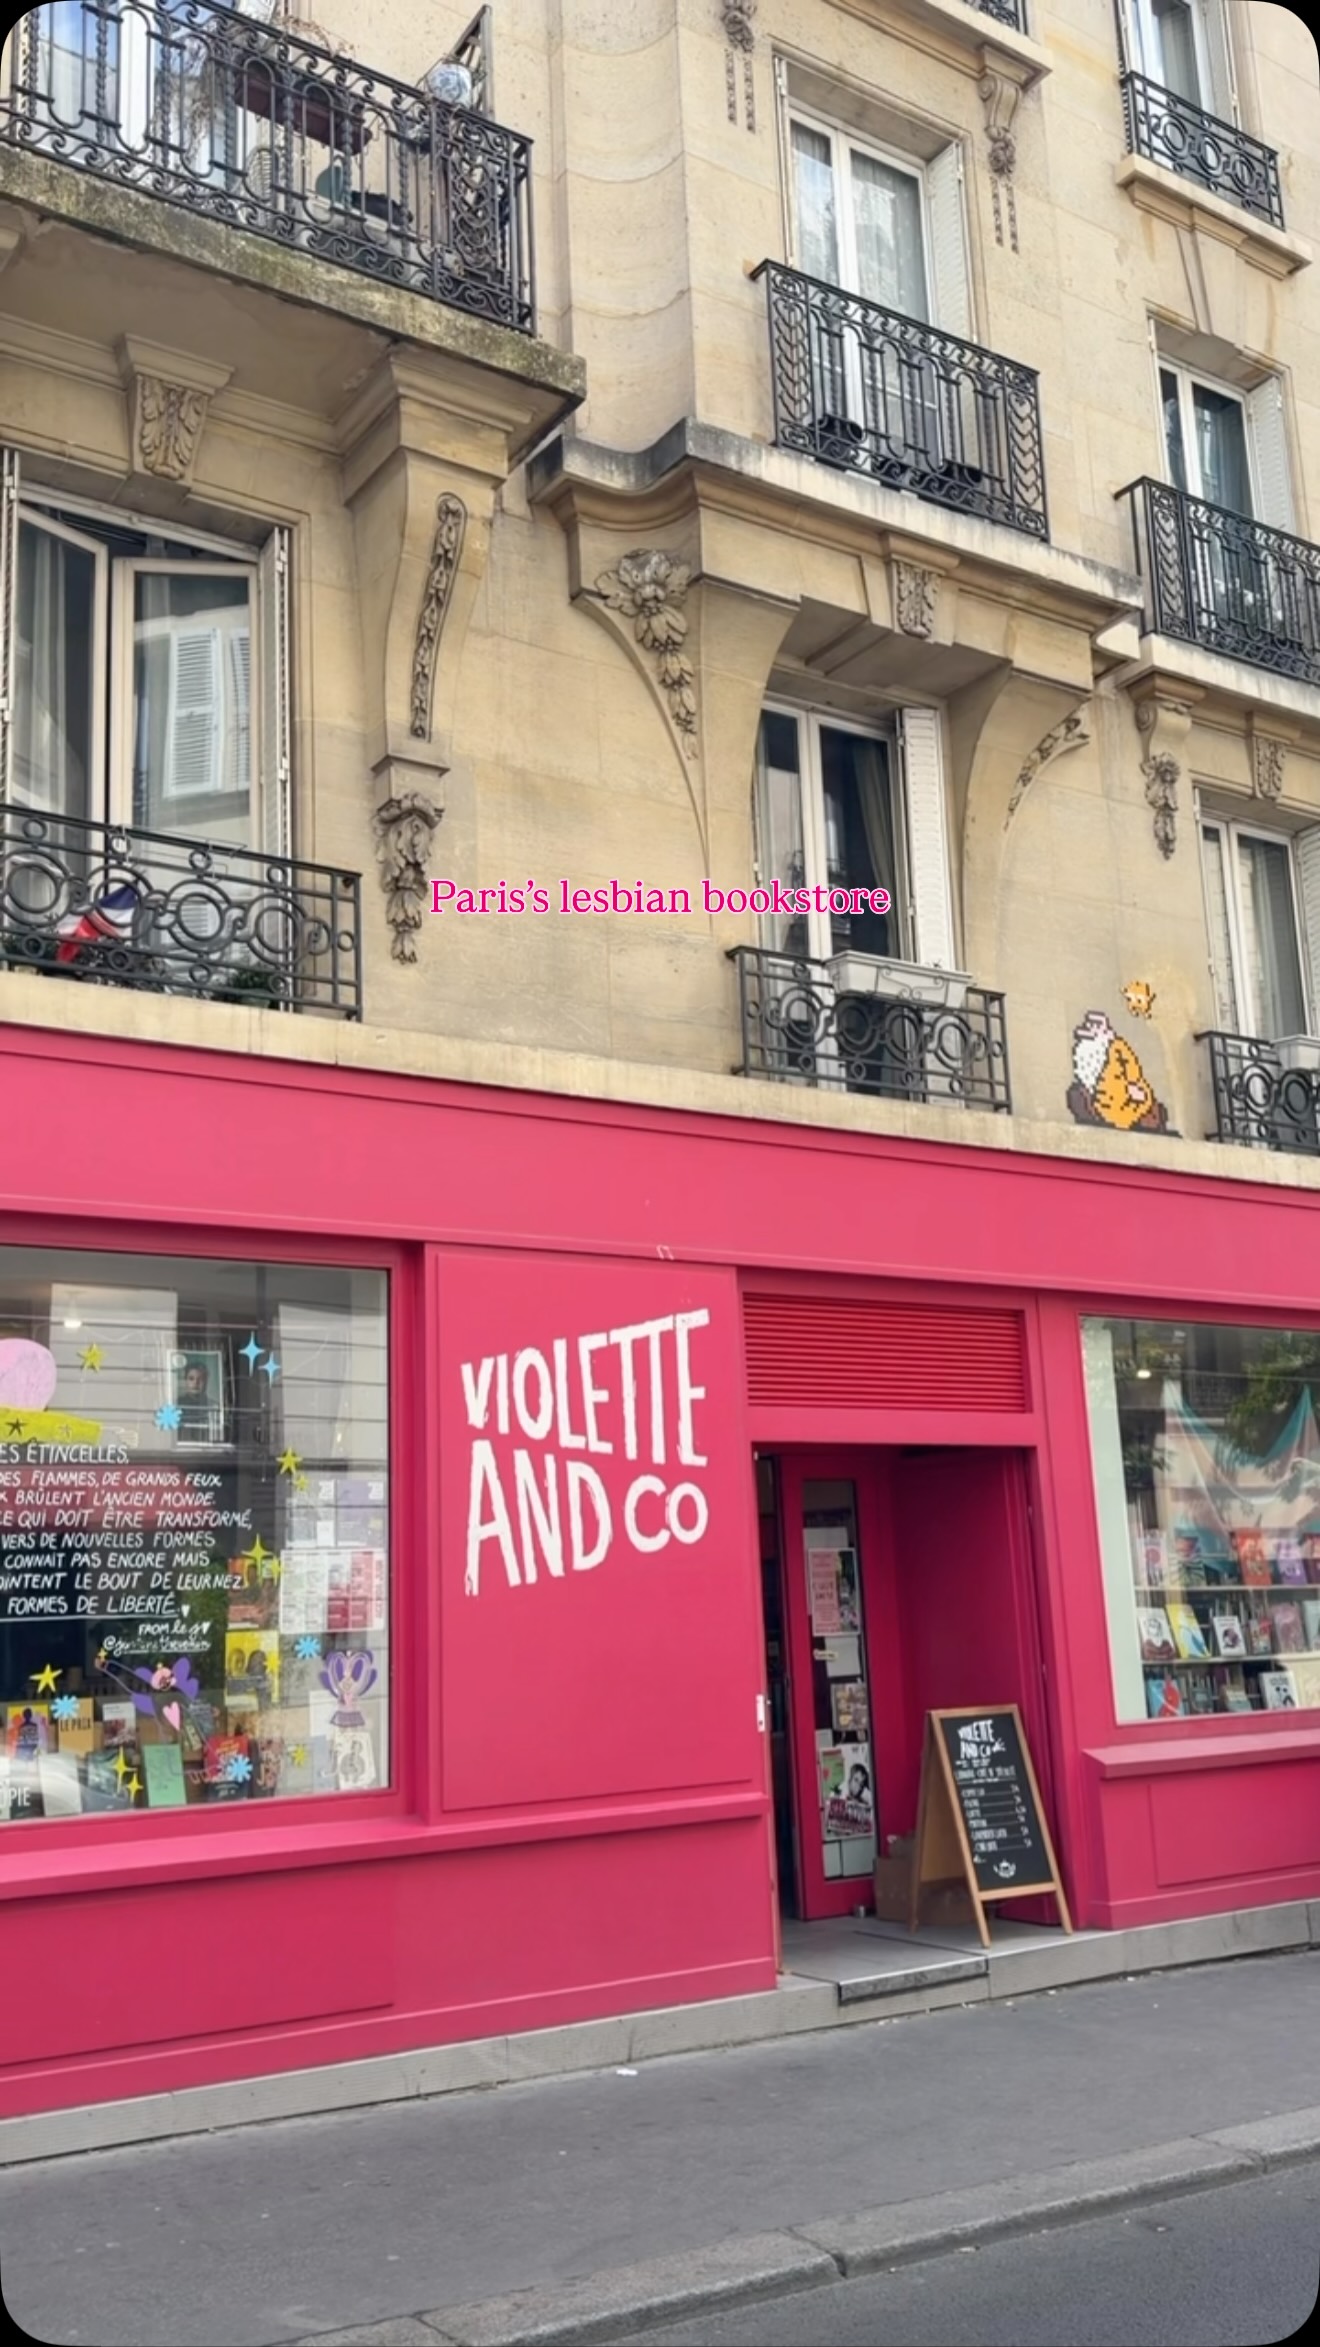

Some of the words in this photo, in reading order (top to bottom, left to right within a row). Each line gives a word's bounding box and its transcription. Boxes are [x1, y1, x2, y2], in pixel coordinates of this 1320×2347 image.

[460, 1308, 710, 1467] VIOLETTE
[102, 1472, 122, 1486] DE
[126, 1470, 180, 1487] GRANDS
[15, 1486, 85, 1506] BRÛLENT
[54, 1508, 94, 1527] DOIT
[102, 1506, 144, 1529] ÊTRE
[464, 1439, 613, 1596] AND
[1, 1532, 36, 1550] VERS
[40, 1532, 58, 1550] DE
[61, 1532, 144, 1549] NOUVELLES
[153, 1531, 216, 1549] FORMES
[70, 1551, 102, 1569] PAS
[107, 1552, 166, 1569] ENCORE
[172, 1550, 210, 1568] MAIS
[74, 1573, 93, 1590] LE
[97, 1572, 143, 1590] BOUT
[150, 1571, 173, 1590] DE
[7, 1596, 69, 1615] FORMES
[76, 1595, 99, 1615] DE
[138, 1623, 170, 1635] FROM
